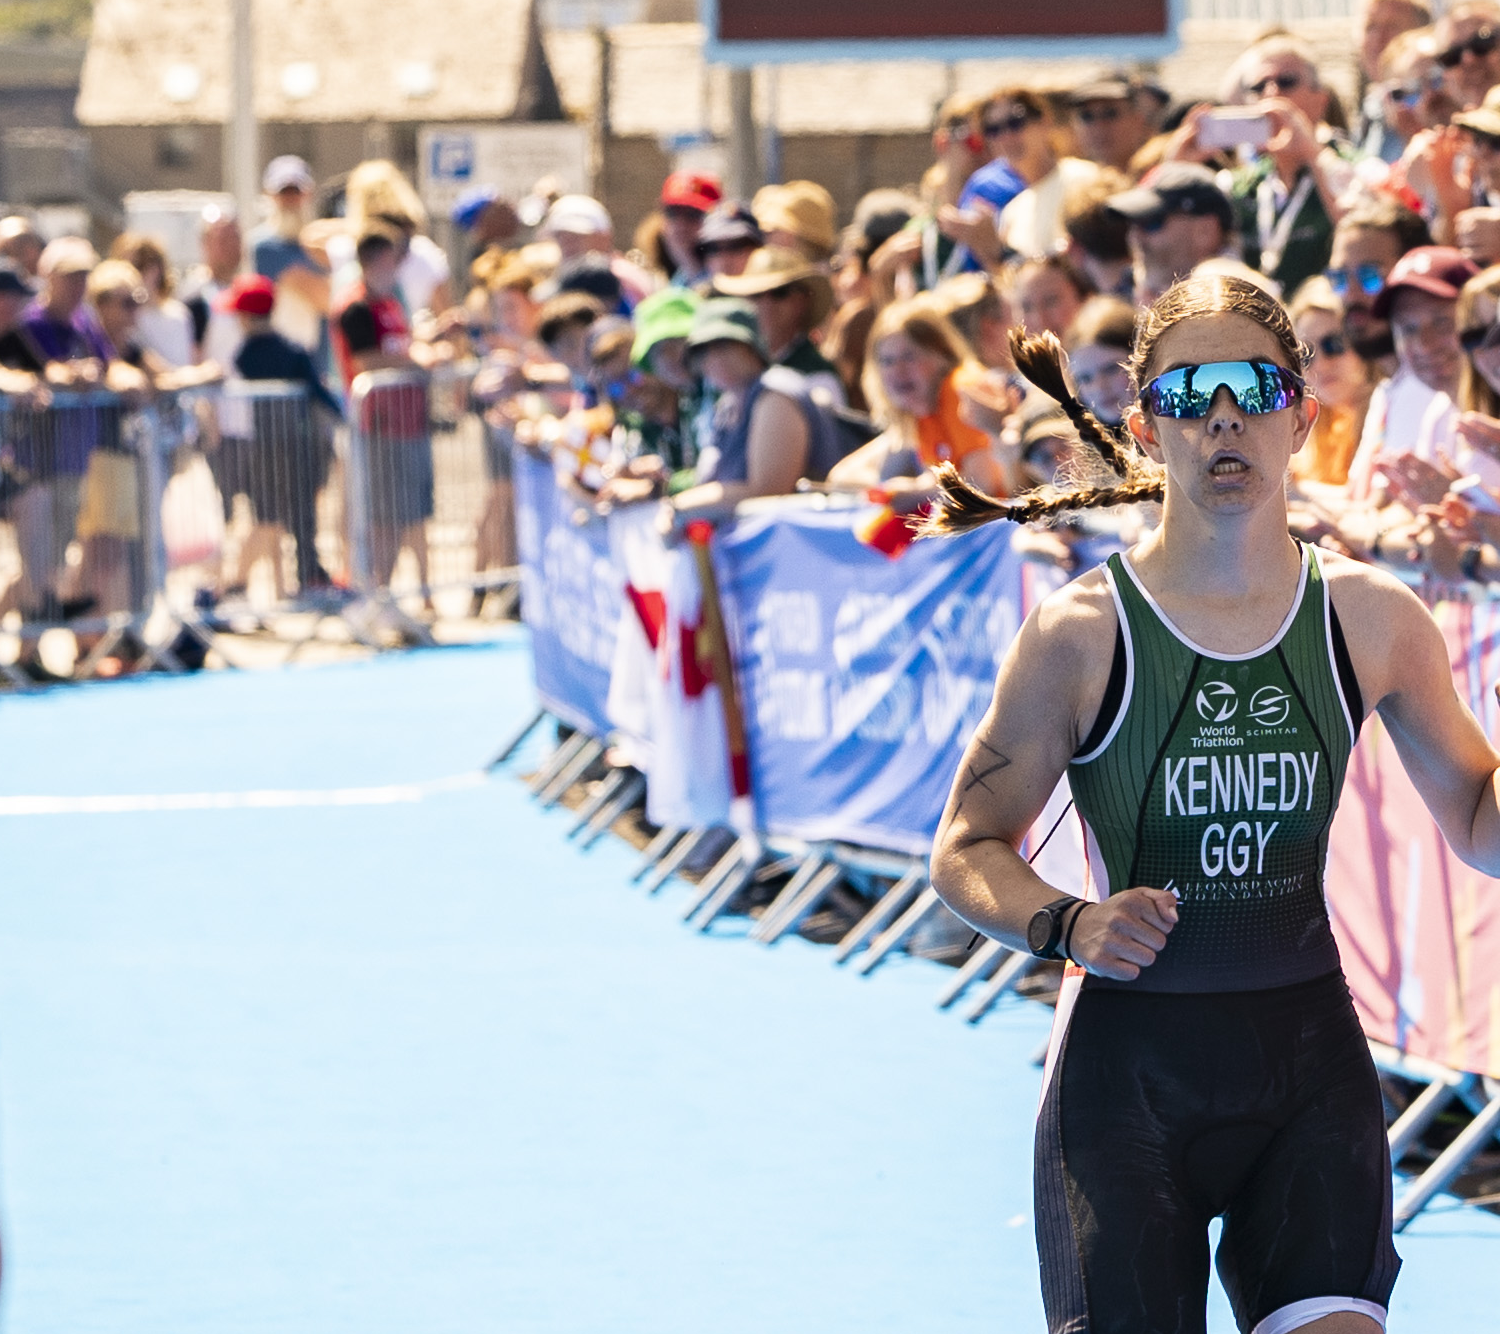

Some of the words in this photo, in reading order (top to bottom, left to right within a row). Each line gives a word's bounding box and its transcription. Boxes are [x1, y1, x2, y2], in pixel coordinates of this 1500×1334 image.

[1199, 725, 1236, 737] World
[1246, 727, 1299, 737] SCIMITAR
[1190, 737, 1245, 748] Triathlon
[1165, 751, 1320, 817] KENNEDY
[1201, 821, 1280, 878] GGY
